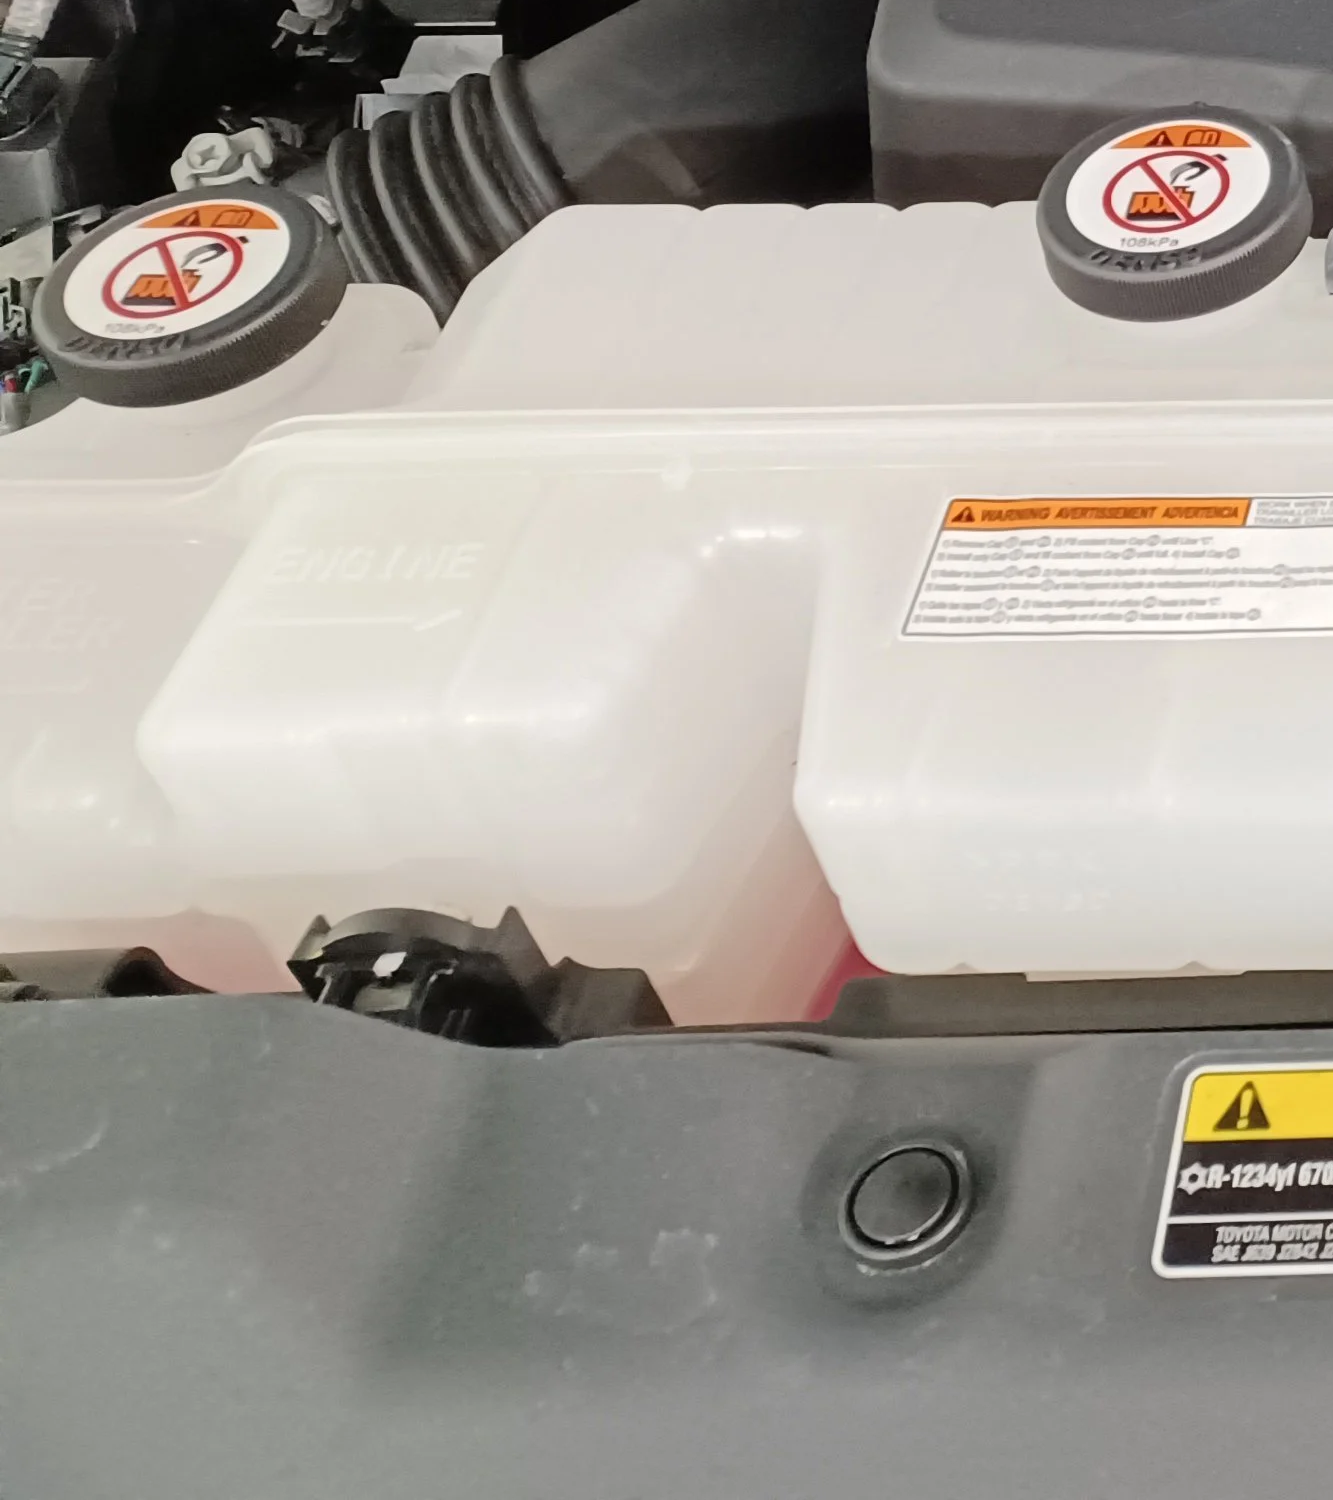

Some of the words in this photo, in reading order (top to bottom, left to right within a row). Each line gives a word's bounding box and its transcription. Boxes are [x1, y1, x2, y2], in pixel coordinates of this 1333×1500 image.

[981, 507, 1050, 521] WARNING
[268, 542, 485, 582] ENGINE
[1216, 1225, 1270, 1243] TOYOTA
[1272, 1223, 1324, 1242] MOTOR
